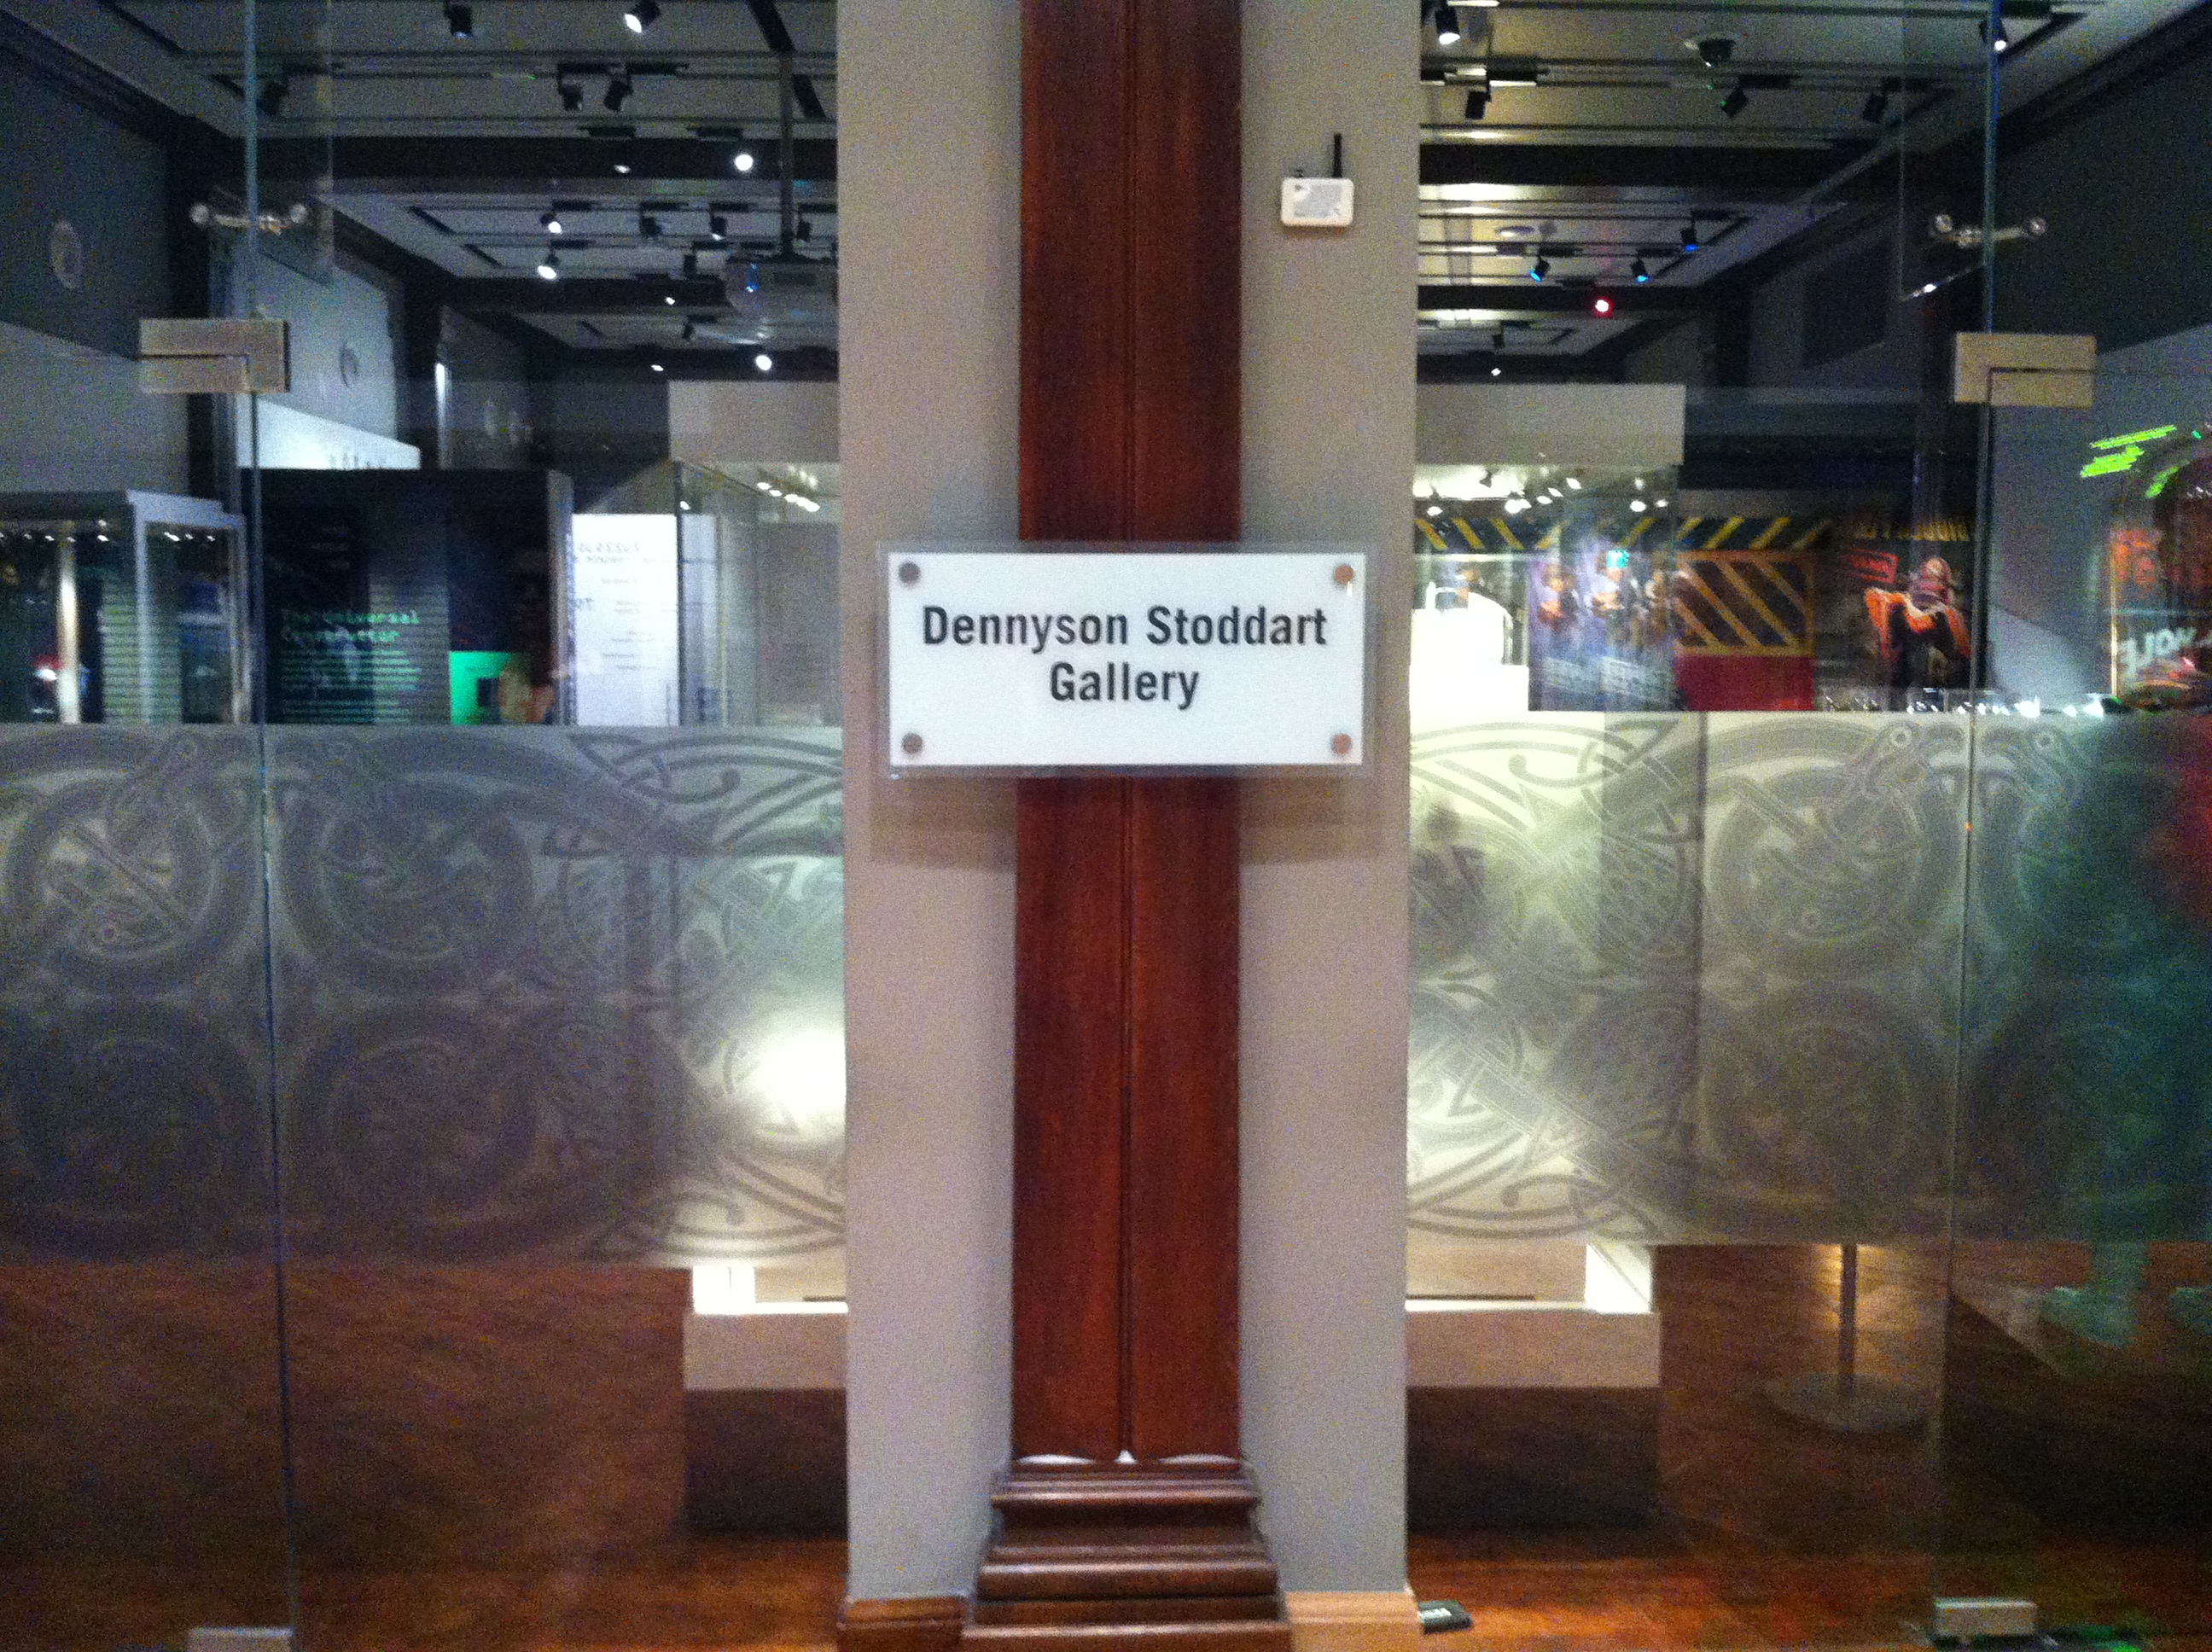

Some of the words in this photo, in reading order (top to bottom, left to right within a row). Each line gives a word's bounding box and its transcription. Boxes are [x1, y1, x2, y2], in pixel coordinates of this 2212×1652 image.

[923, 605, 1128, 654] Dennyson
[1146, 604, 1327, 646] Stoddart
[1050, 661, 1199, 710] Gallery
